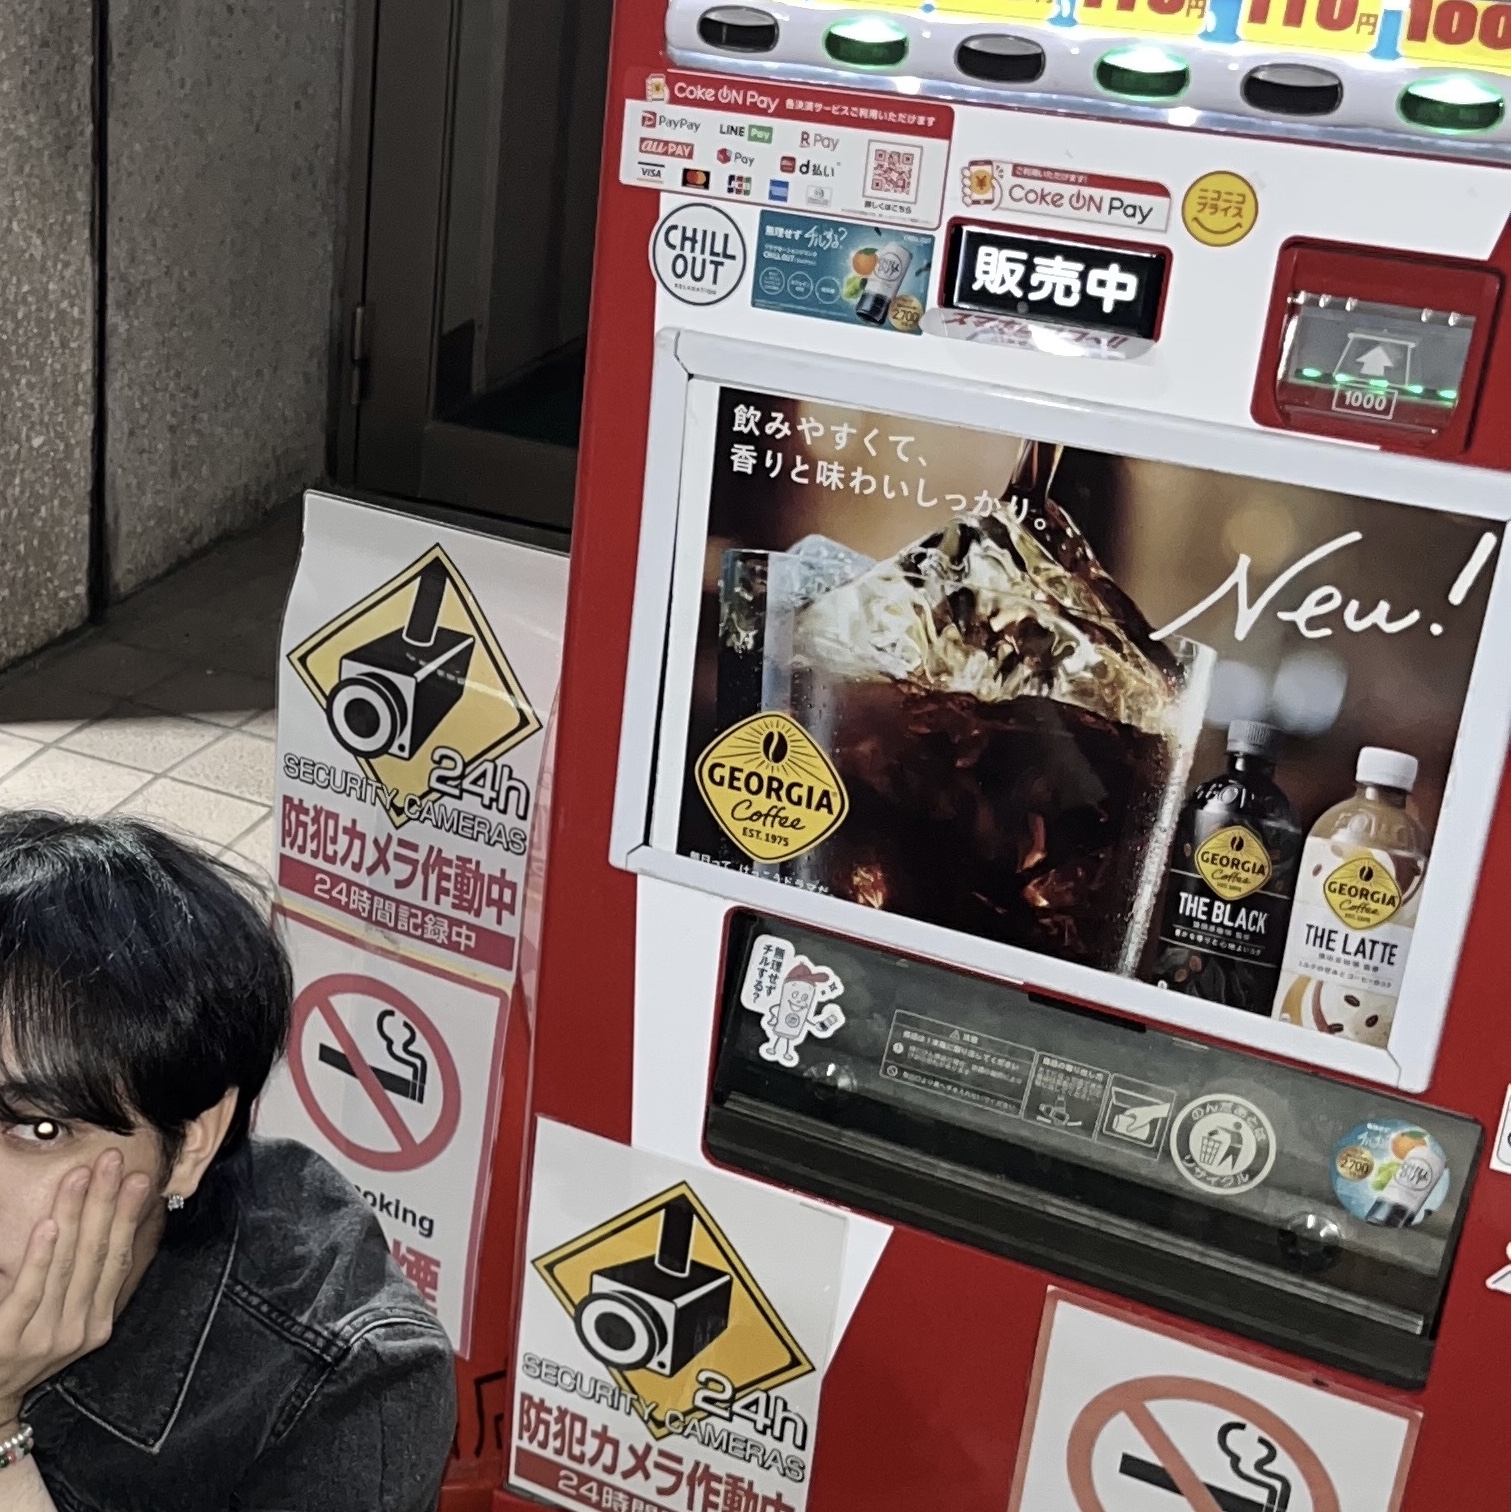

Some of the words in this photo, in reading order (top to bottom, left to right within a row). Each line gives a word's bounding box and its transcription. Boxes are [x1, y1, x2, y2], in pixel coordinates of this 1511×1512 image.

[674, 82, 715, 102] Coke
[746, 90, 779, 113] Pay
[659, 115, 701, 133] PayPay
[719, 124, 745, 137] LINE
[750, 128, 771, 140] Pay
[813, 133, 840, 151] Pay
[641, 140, 668, 152] au
[668, 143, 693, 158] PAY
[734, 152, 756, 167] Pay
[641, 167, 663, 178] VISA
[799, 160, 835, 177] d払い
[1008, 183, 1065, 208] Coke
[1108, 196, 1154, 225] Pay
[1198, 187, 1247, 204] ニコニコ
[664, 224, 736, 261] CHILL
[671, 253, 725, 285] OUT
[971, 245, 1139, 314] 販売中
[1344, 390, 1387, 411] 1000
[733, 403, 927, 467] 飲みやすくて、
[730, 443, 1047, 531] 香りと味わいしっかり。
[1149, 531, 1498, 641] New!
[427, 745, 530, 820] 24h
[707, 762, 834, 816] GEORGIA
[283, 752, 399, 813] SECURITY
[403, 793, 528, 856] CAMERAS
[731, 799, 806, 830] Coffee
[742, 826, 763, 841] EST.
[764, 832, 790, 847] 1975
[280, 794, 519, 928] 防犯カメラ作動中
[1200, 850, 1266, 876] GEORGIA
[313, 871, 477, 954] 24時間記録中
[1327, 880, 1396, 908] GEORGIA
[1178, 891, 1210, 920] THE
[1211, 900, 1268, 935] BLACK
[1305, 923, 1338, 952] THE
[1341, 933, 1398, 966] LATTE
[354, 1184, 435, 1239] oking
[521, 1352, 659, 1423] SECURITY
[663, 1406, 806, 1483] CAMERAS
[692, 1368, 809, 1451] 24h
